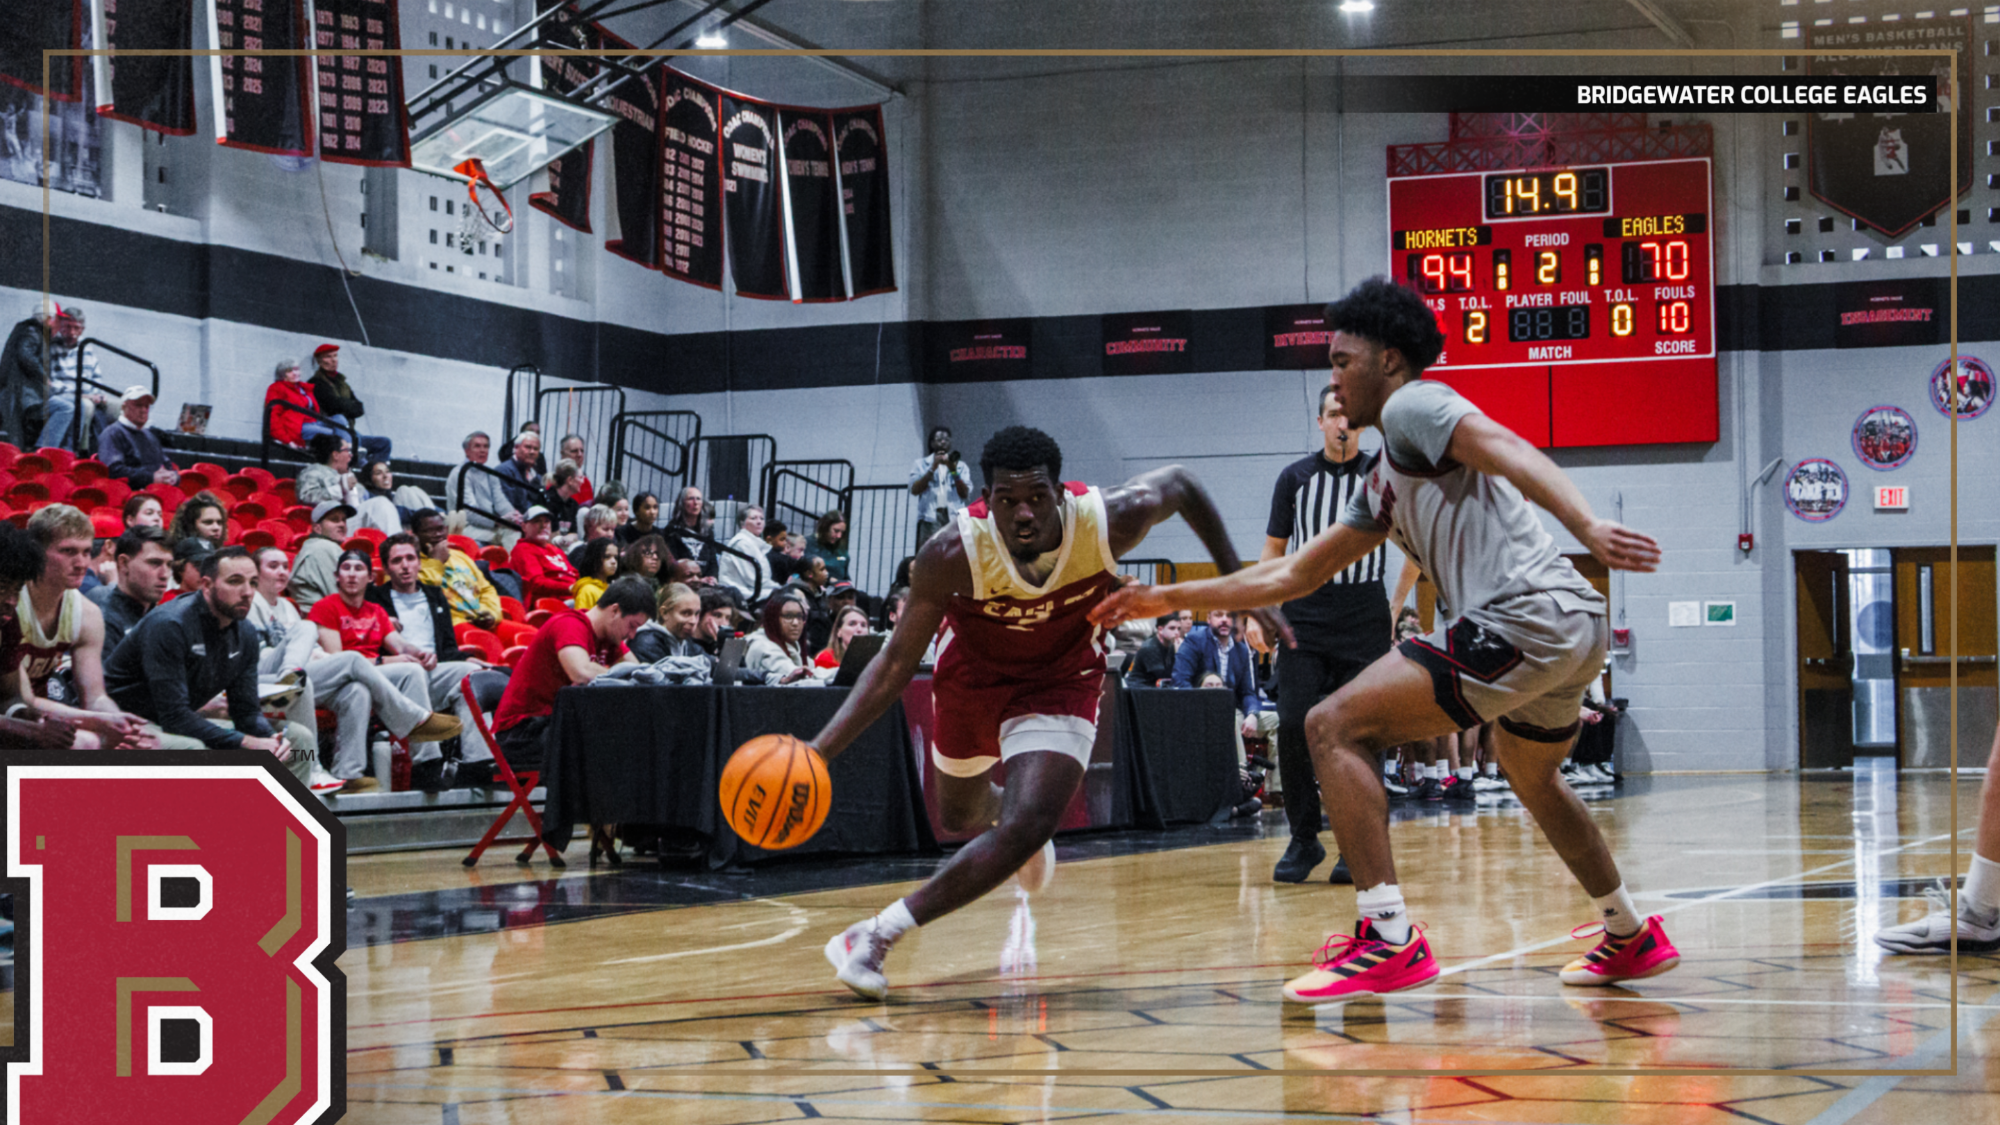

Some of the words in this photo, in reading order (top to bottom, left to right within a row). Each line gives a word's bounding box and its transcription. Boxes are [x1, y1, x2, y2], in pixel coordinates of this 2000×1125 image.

[1814, 33, 1860, 46] MEN'S
[1866, 26, 1965, 43] BASKETBALL
[1506, 173, 1577, 214] 14.9
[1621, 215, 1685, 237] EAGLES
[1405, 228, 1478, 249] HORNETS
[1525, 232, 1570, 248] PERIOD
[1538, 252, 1557, 283] 2
[1640, 241, 1689, 280] 70
[1423, 254, 1472, 291] 94
[1506, 293, 1553, 308] PLAYER
[1560, 290, 1592, 305] FOUL
[1604, 289, 1639, 304] T.O.L.
[1654, 285, 1696, 300] FOULS
[1458, 295, 1493, 310] T.O.L.
[1612, 304, 1632, 336] 0
[1660, 301, 1689, 332] 10
[1840, 308, 1933, 326] ENGAGEMENT
[1467, 311, 1486, 343] 2
[949, 345, 1027, 362] CHARACTER
[1105, 338, 1188, 355] COMMUNITY
[1528, 346, 1572, 360] MATCH
[1655, 340, 1696, 354] SCORE
[1880, 488, 1905, 507] EXIT
